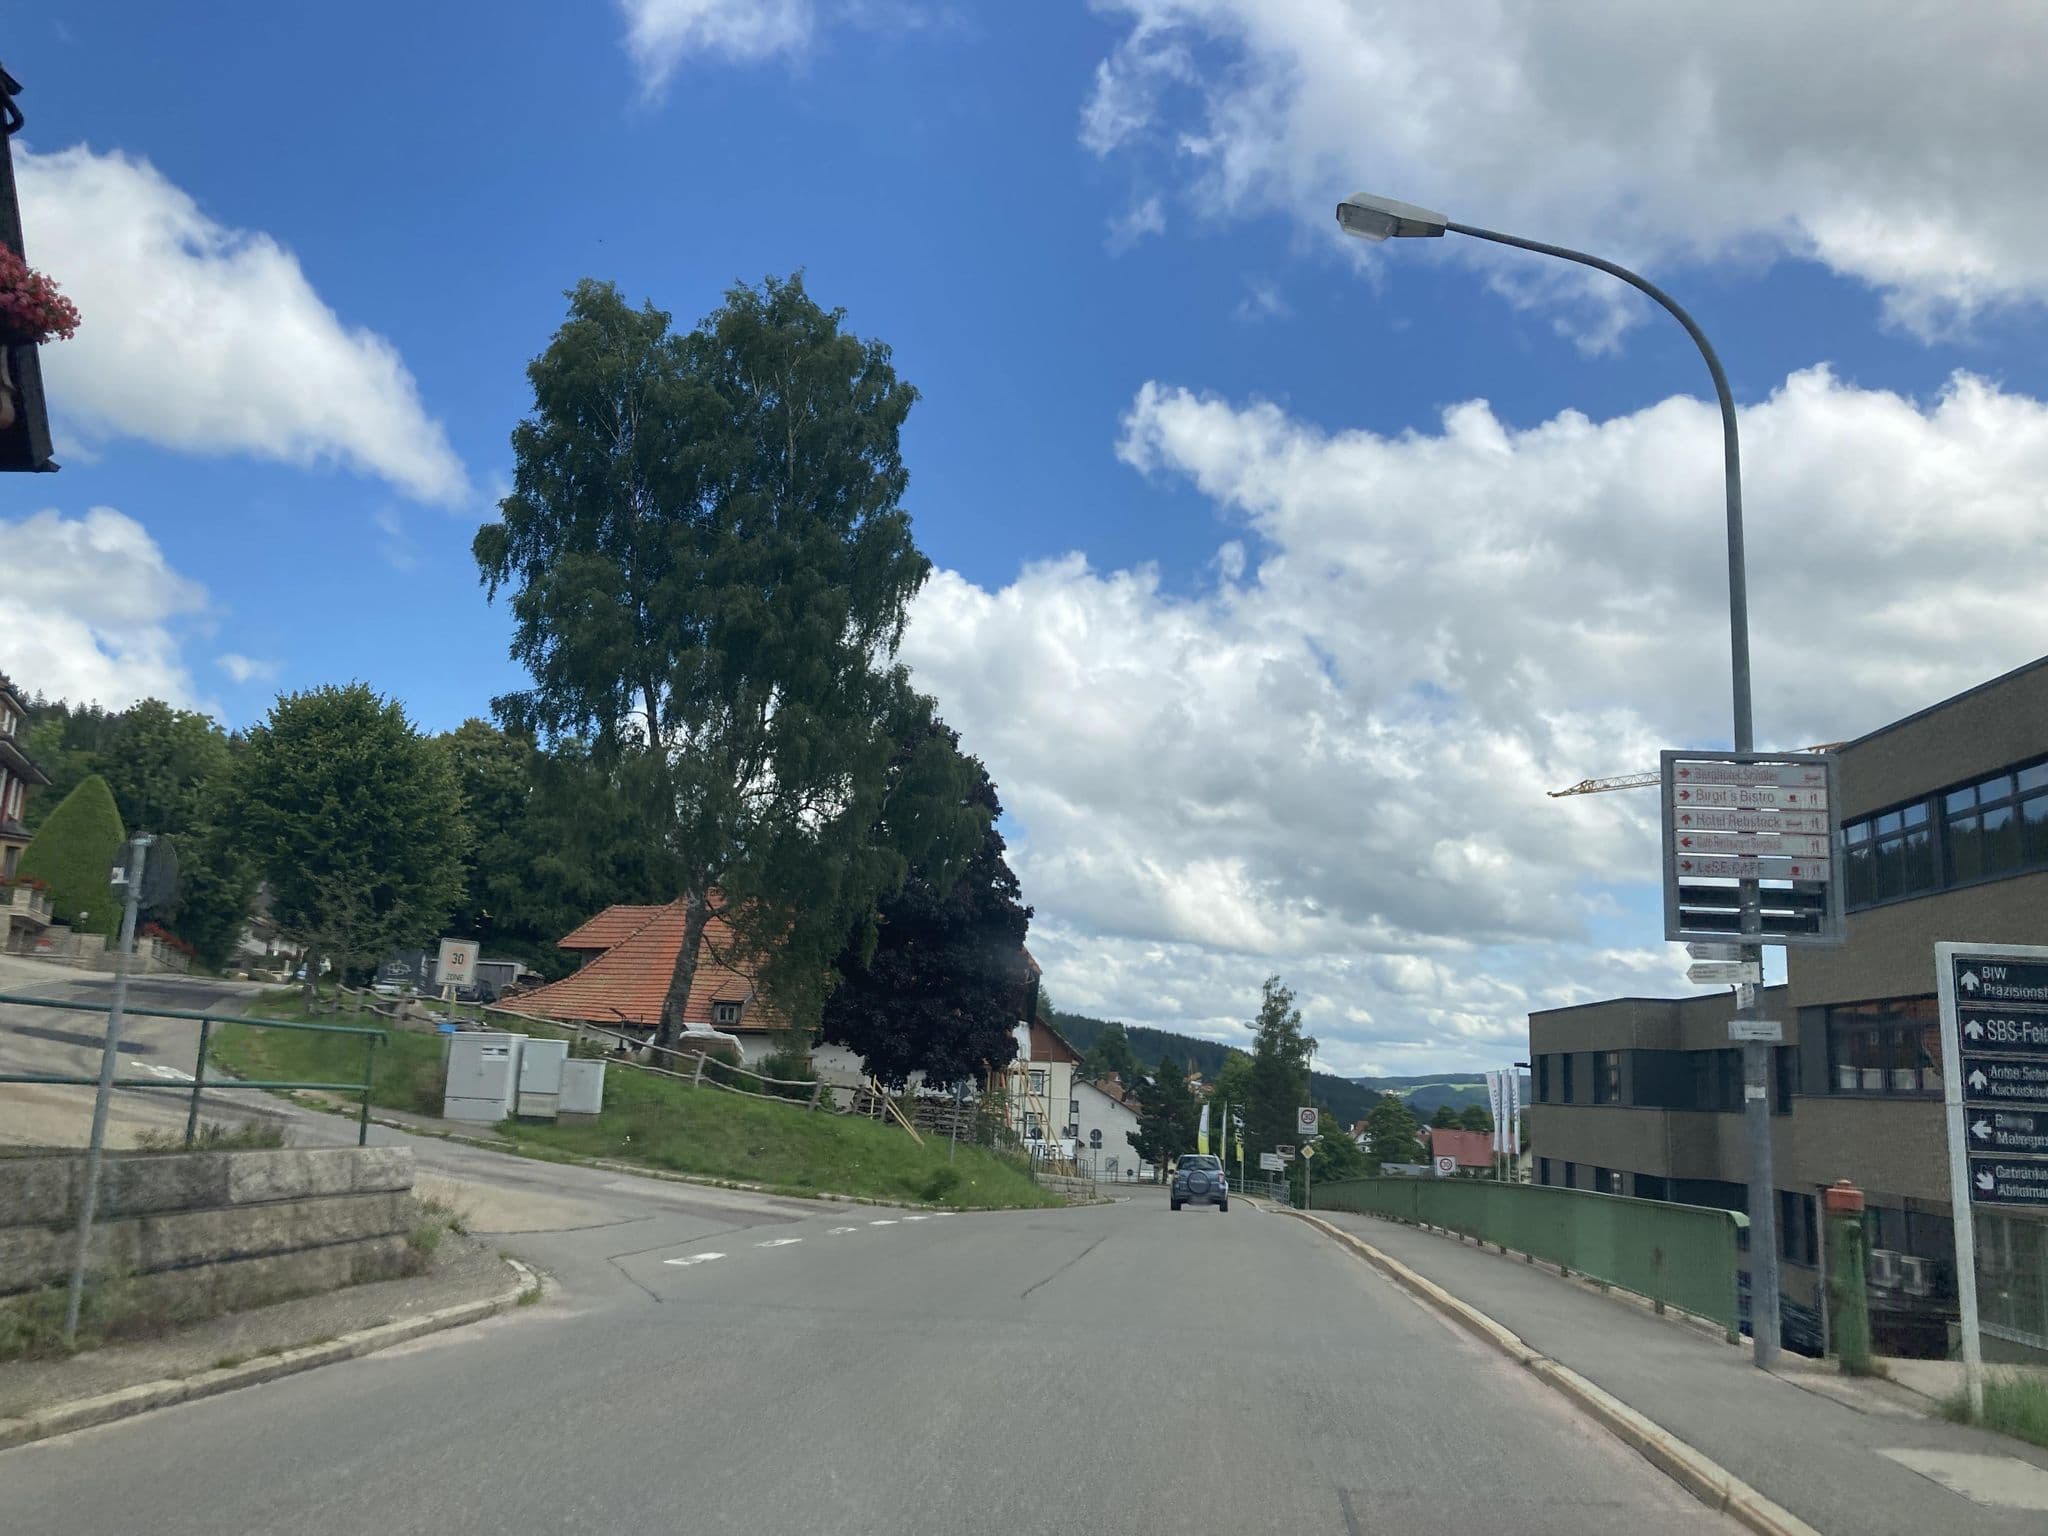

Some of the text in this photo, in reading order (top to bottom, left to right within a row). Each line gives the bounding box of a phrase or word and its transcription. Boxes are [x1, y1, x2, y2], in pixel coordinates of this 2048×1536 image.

[1740, 790, 1775, 803] Bistro
[452, 953, 464, 965] 30
[446, 973, 464, 981] ZONE
[1982, 966, 2007, 980] BIW
